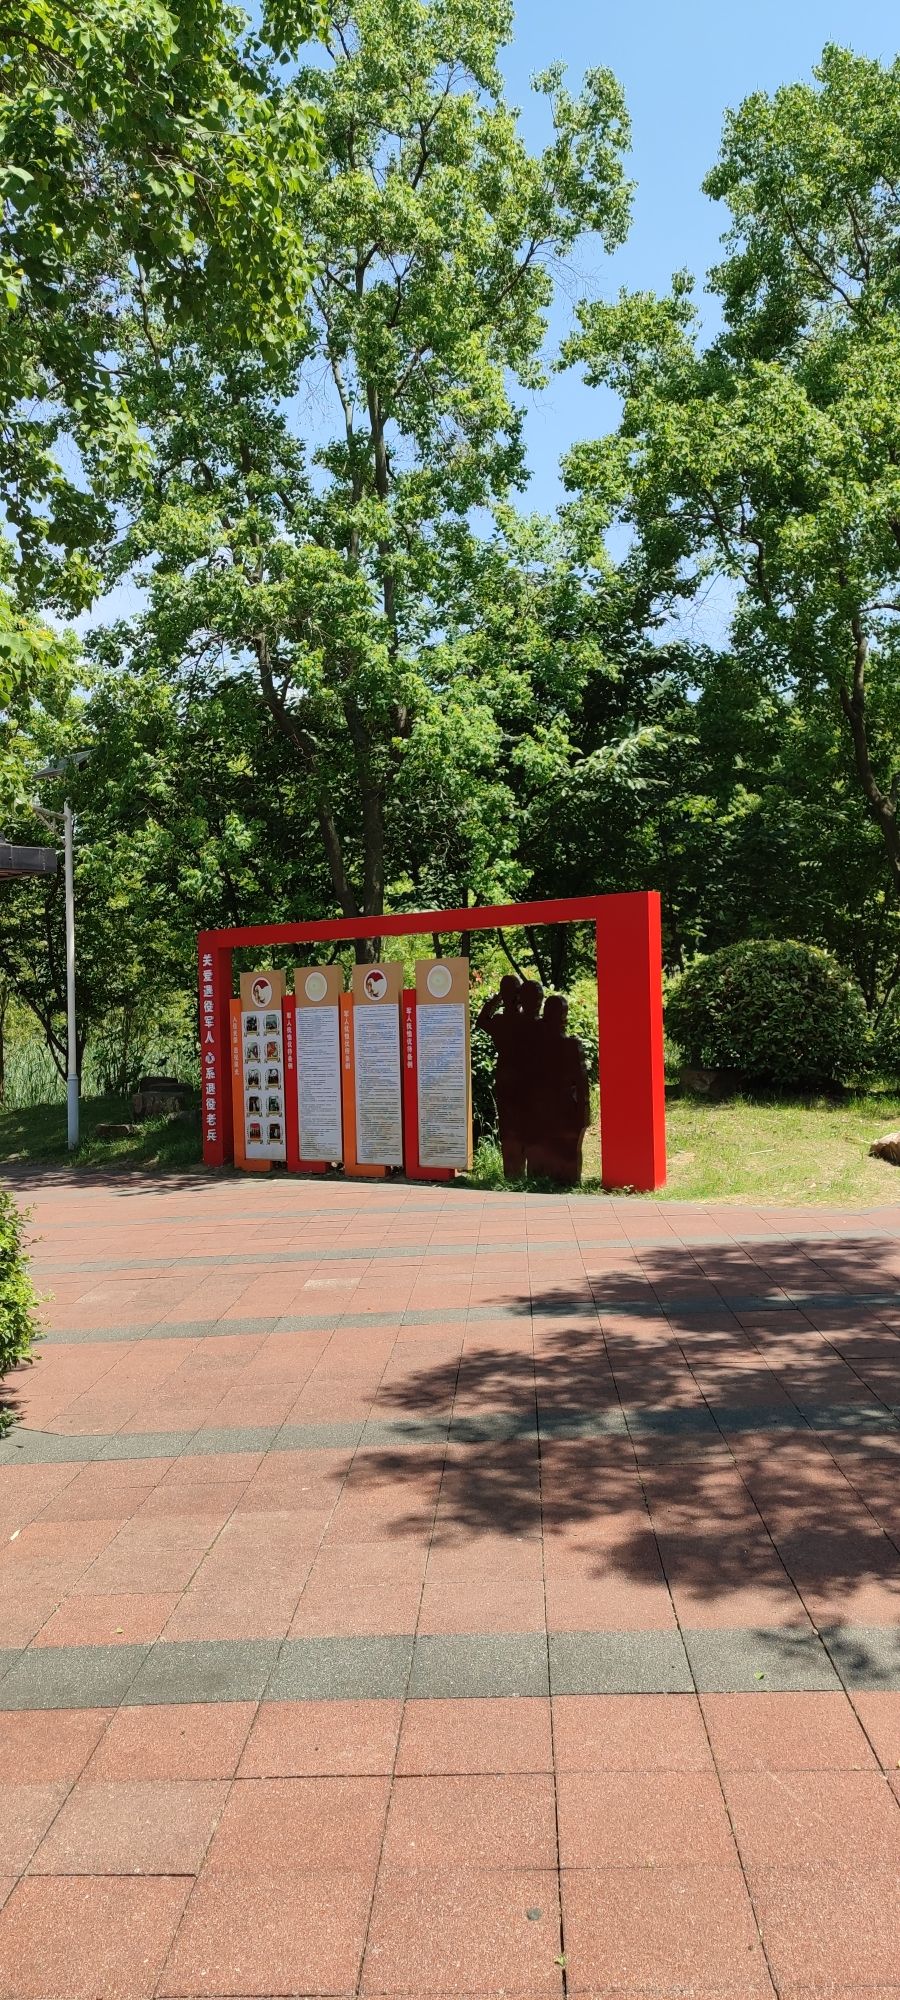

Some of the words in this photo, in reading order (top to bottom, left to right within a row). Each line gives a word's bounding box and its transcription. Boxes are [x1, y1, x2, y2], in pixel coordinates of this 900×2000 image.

[202, 953, 214, 1044] 关爱退役军人
[205, 1051, 217, 1142] 心系退役老兵
